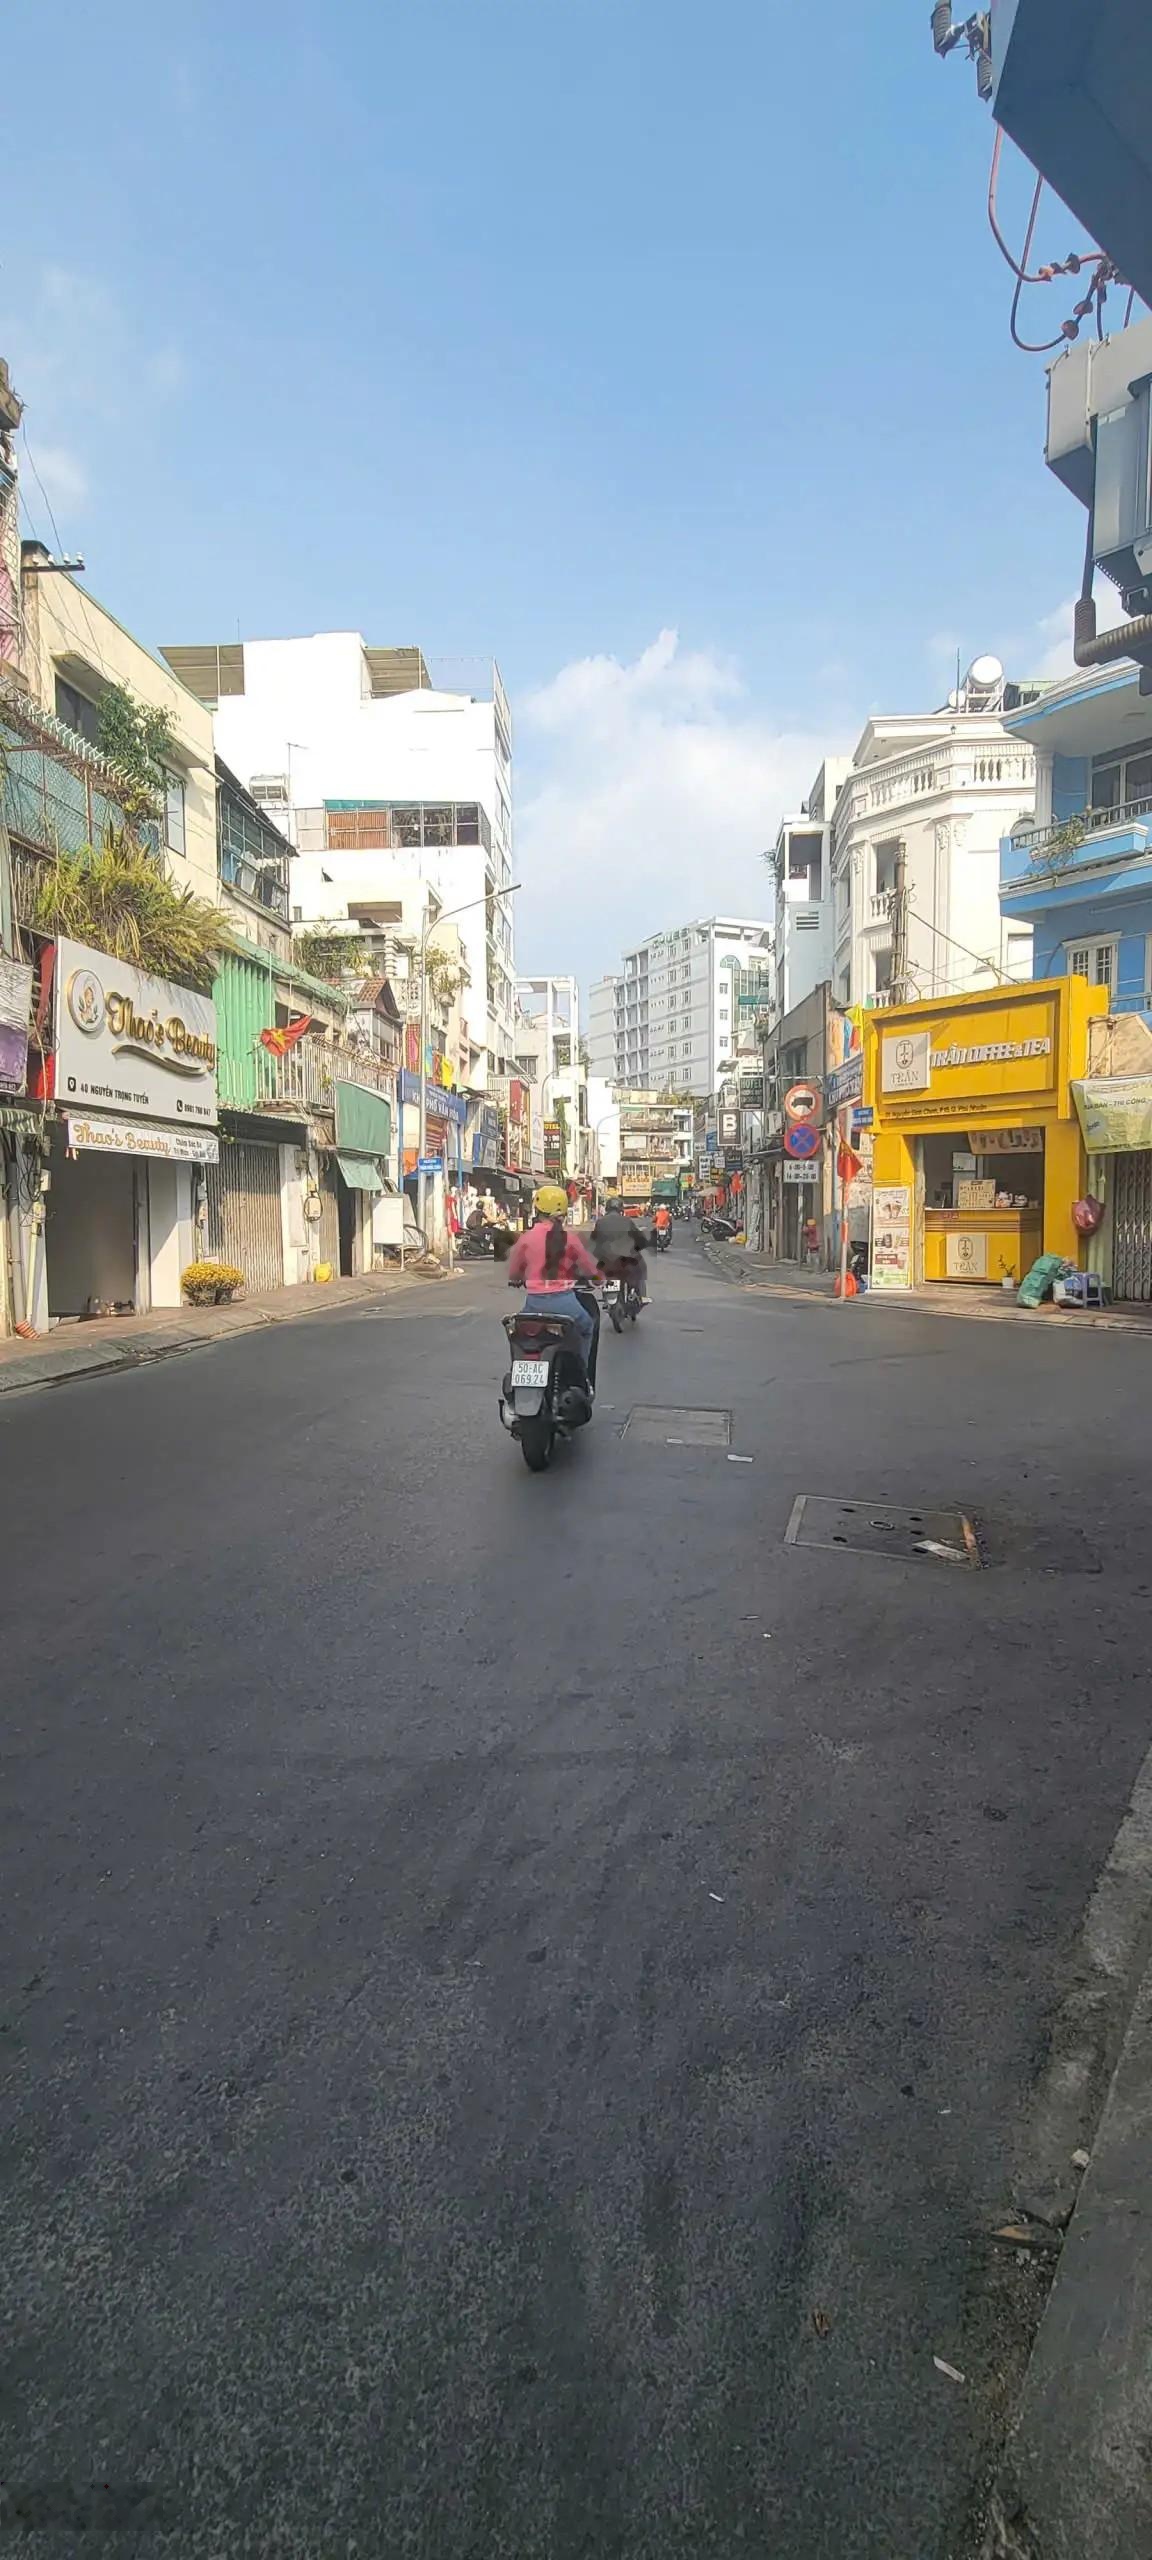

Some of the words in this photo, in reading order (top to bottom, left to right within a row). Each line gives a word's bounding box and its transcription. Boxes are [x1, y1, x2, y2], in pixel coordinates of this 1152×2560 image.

[165, 1017, 215, 1071] Beauty
[81, 1083, 89, 1094] 40
[723, 1113, 737, 1132] B
[125, 1132, 171, 1155] Beauty
